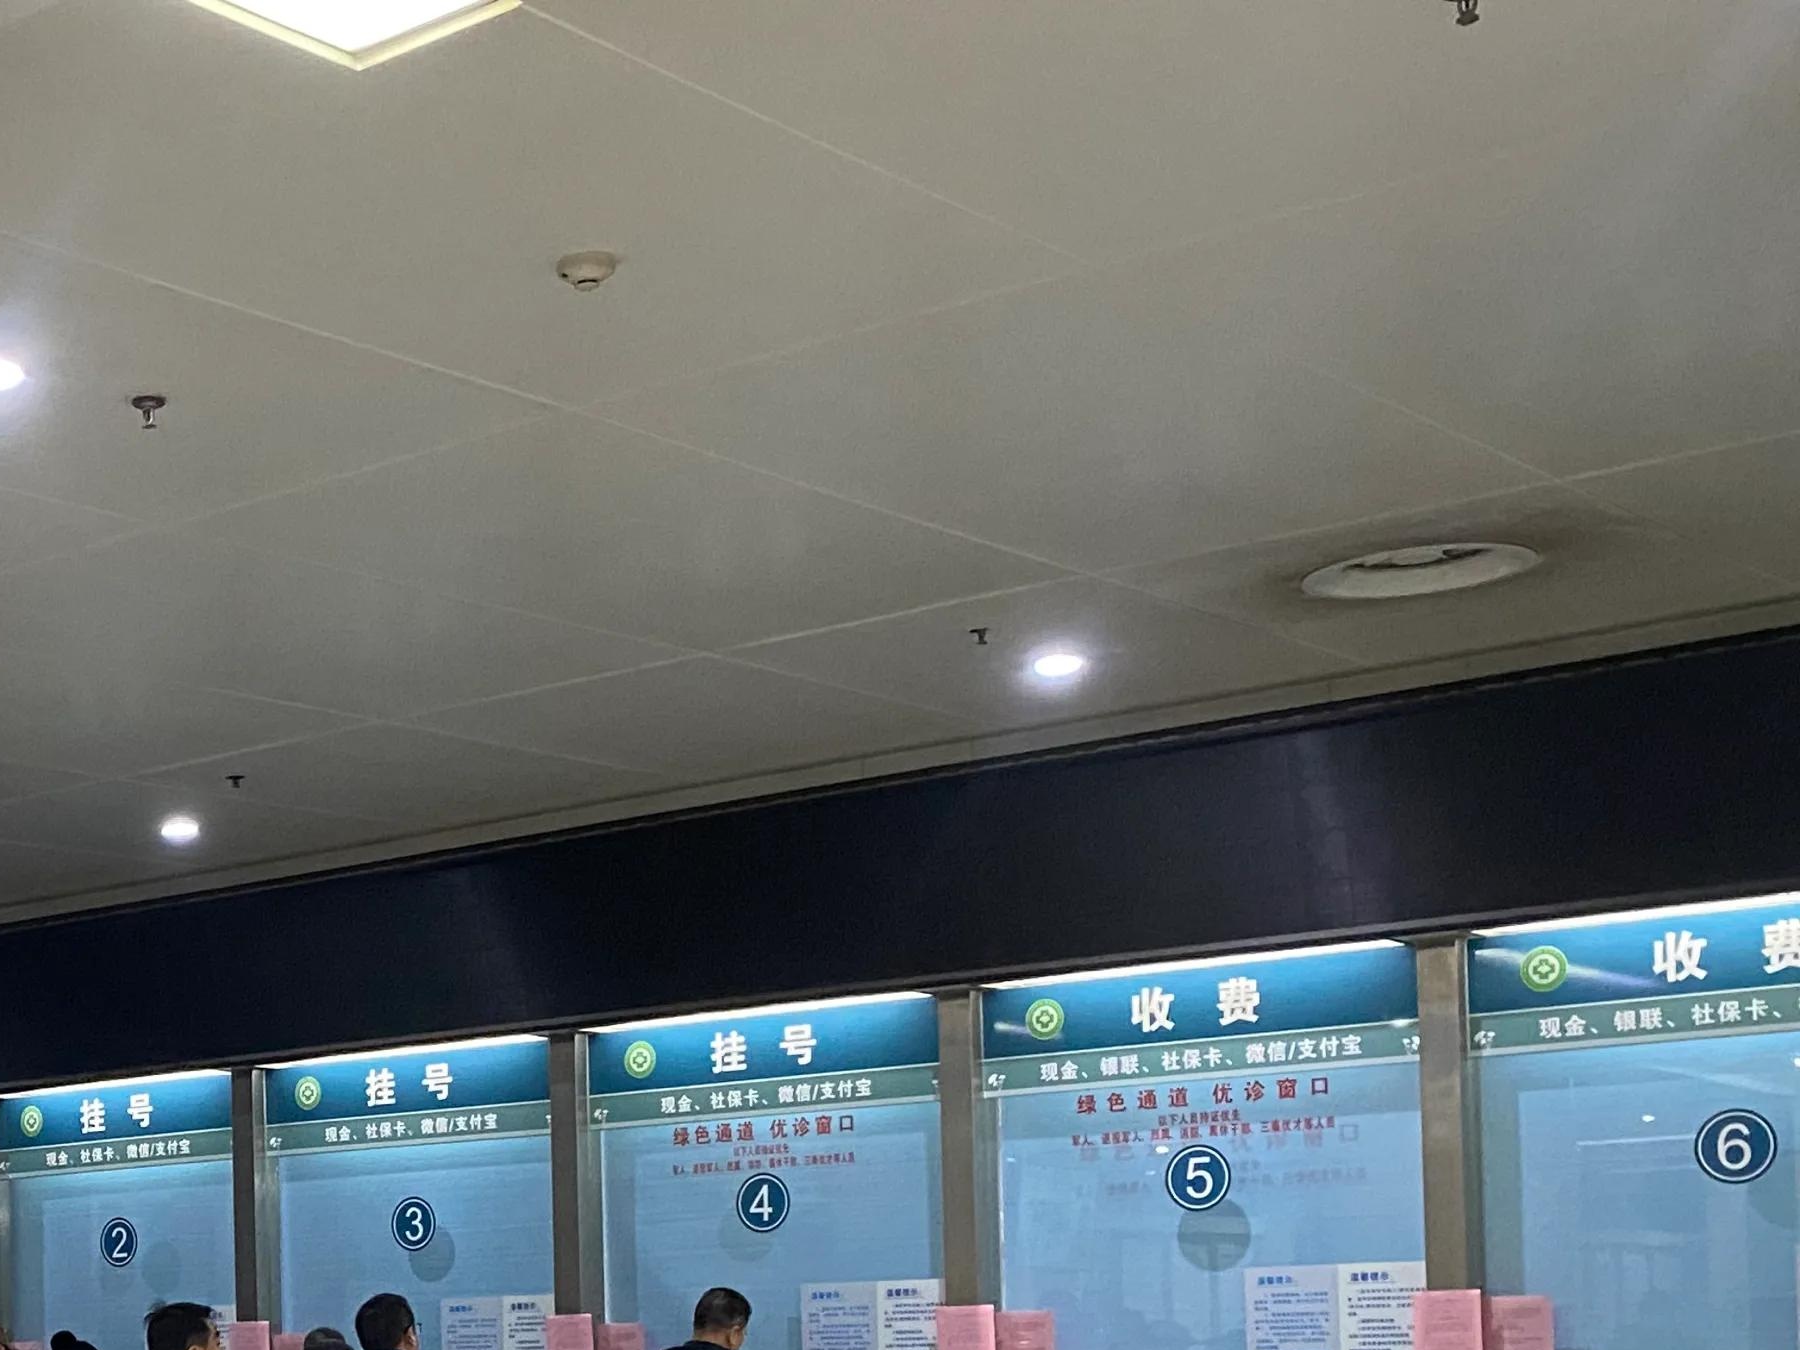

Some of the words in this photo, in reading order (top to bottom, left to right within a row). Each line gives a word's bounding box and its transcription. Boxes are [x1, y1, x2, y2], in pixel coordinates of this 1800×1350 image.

[1653, 918, 1800, 983] 收费
[1131, 976, 1262, 1034] 收费
[1538, 998, 1800, 1039] 现金、银联、社保卡、
[710, 1023, 817, 1074] 挂号
[1039, 1034, 1363, 1083] 现金、银联、社保卡、微信/支付宝
[365, 1062, 453, 1107] 挂号
[660, 1079, 873, 1115] 现金、社保卡、微信/支付宝
[1077, 1087, 1189, 1116] 绿色通道
[1212, 1076, 1329, 1105] 优诊窗口
[80, 1093, 153, 1134] 挂号
[324, 1113, 498, 1142] 现金、社保卡、微信/支付宝
[673, 1120, 755, 1147] 绿色通道
[769, 1114, 855, 1140] 优诊窗口
[1716, 1122, 1752, 1171] 6
[1185, 1156, 1214, 1200] 5
[749, 1183, 774, 1222] 4
[111, 1226, 129, 1259] 2
[404, 1206, 424, 1242] 3
